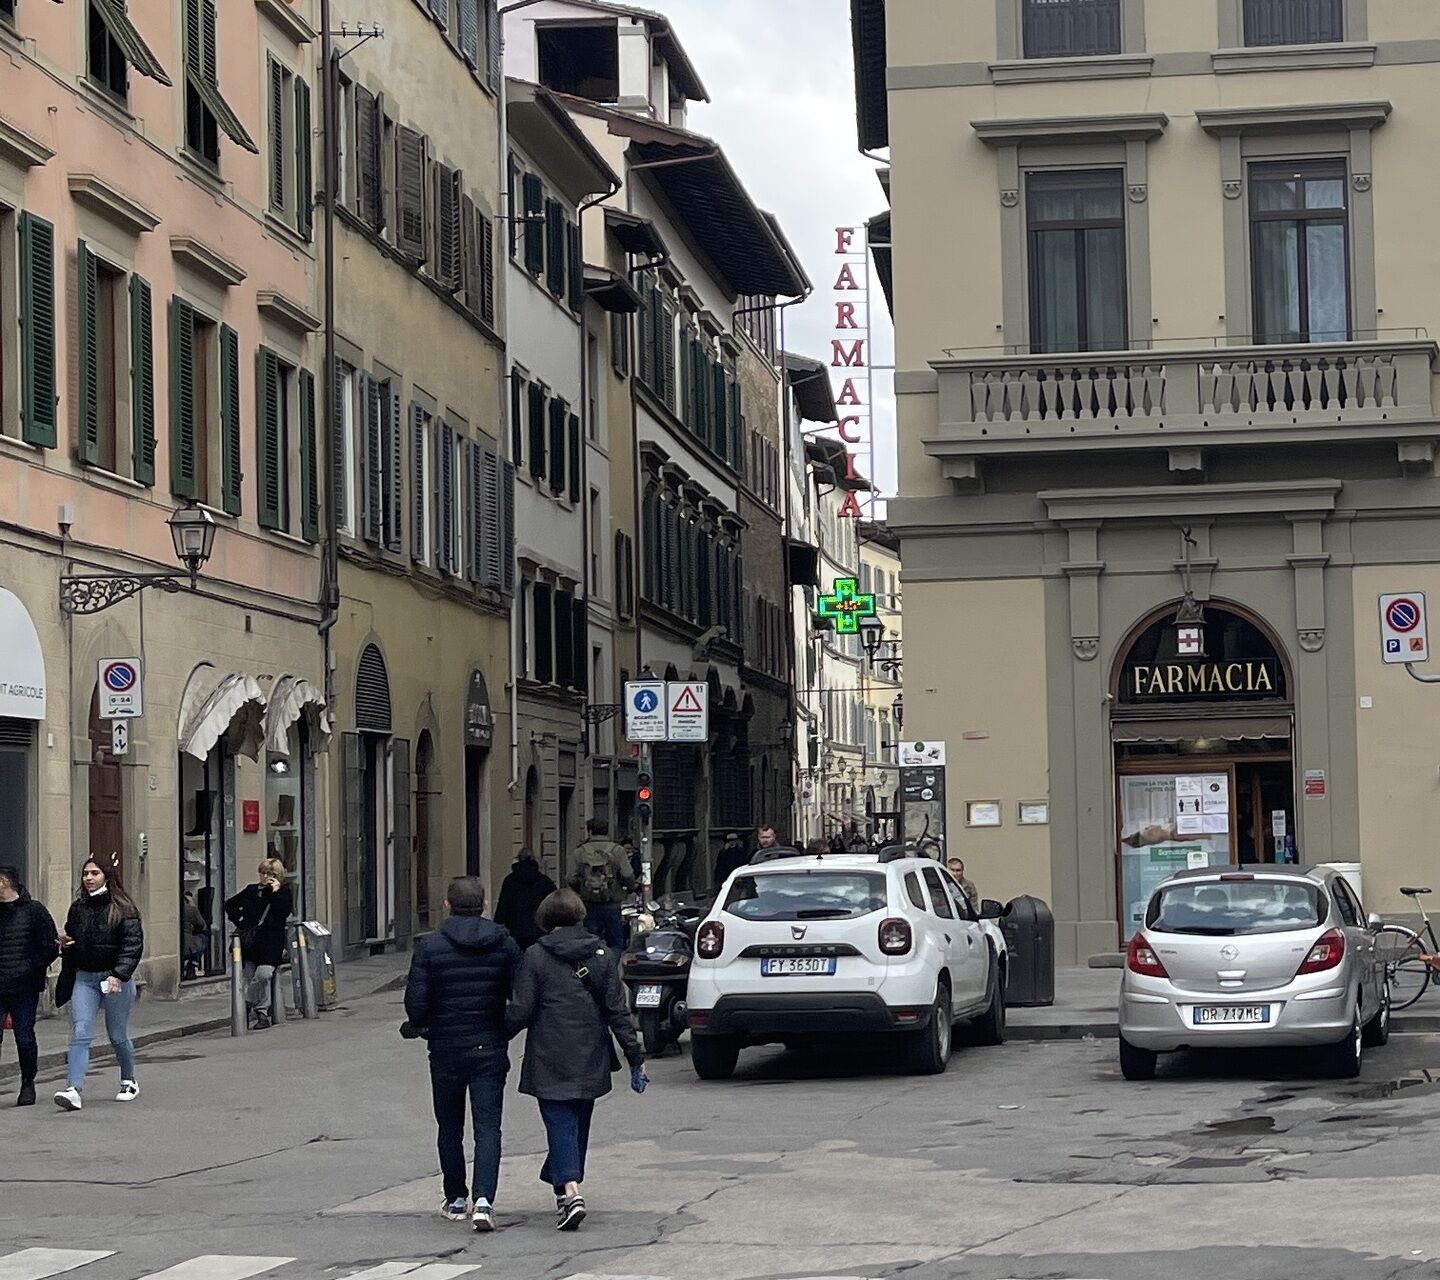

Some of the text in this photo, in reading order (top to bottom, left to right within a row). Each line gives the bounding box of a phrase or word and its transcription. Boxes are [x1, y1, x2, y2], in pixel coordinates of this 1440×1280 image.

[831, 227, 864, 518] FARMACIA
[1134, 663, 1272, 694] FARMACIA
[9, 684, 43, 699] AGRICOLE
[760, 946, 836, 954] DUSTER
[770, 960, 785, 972] FY
